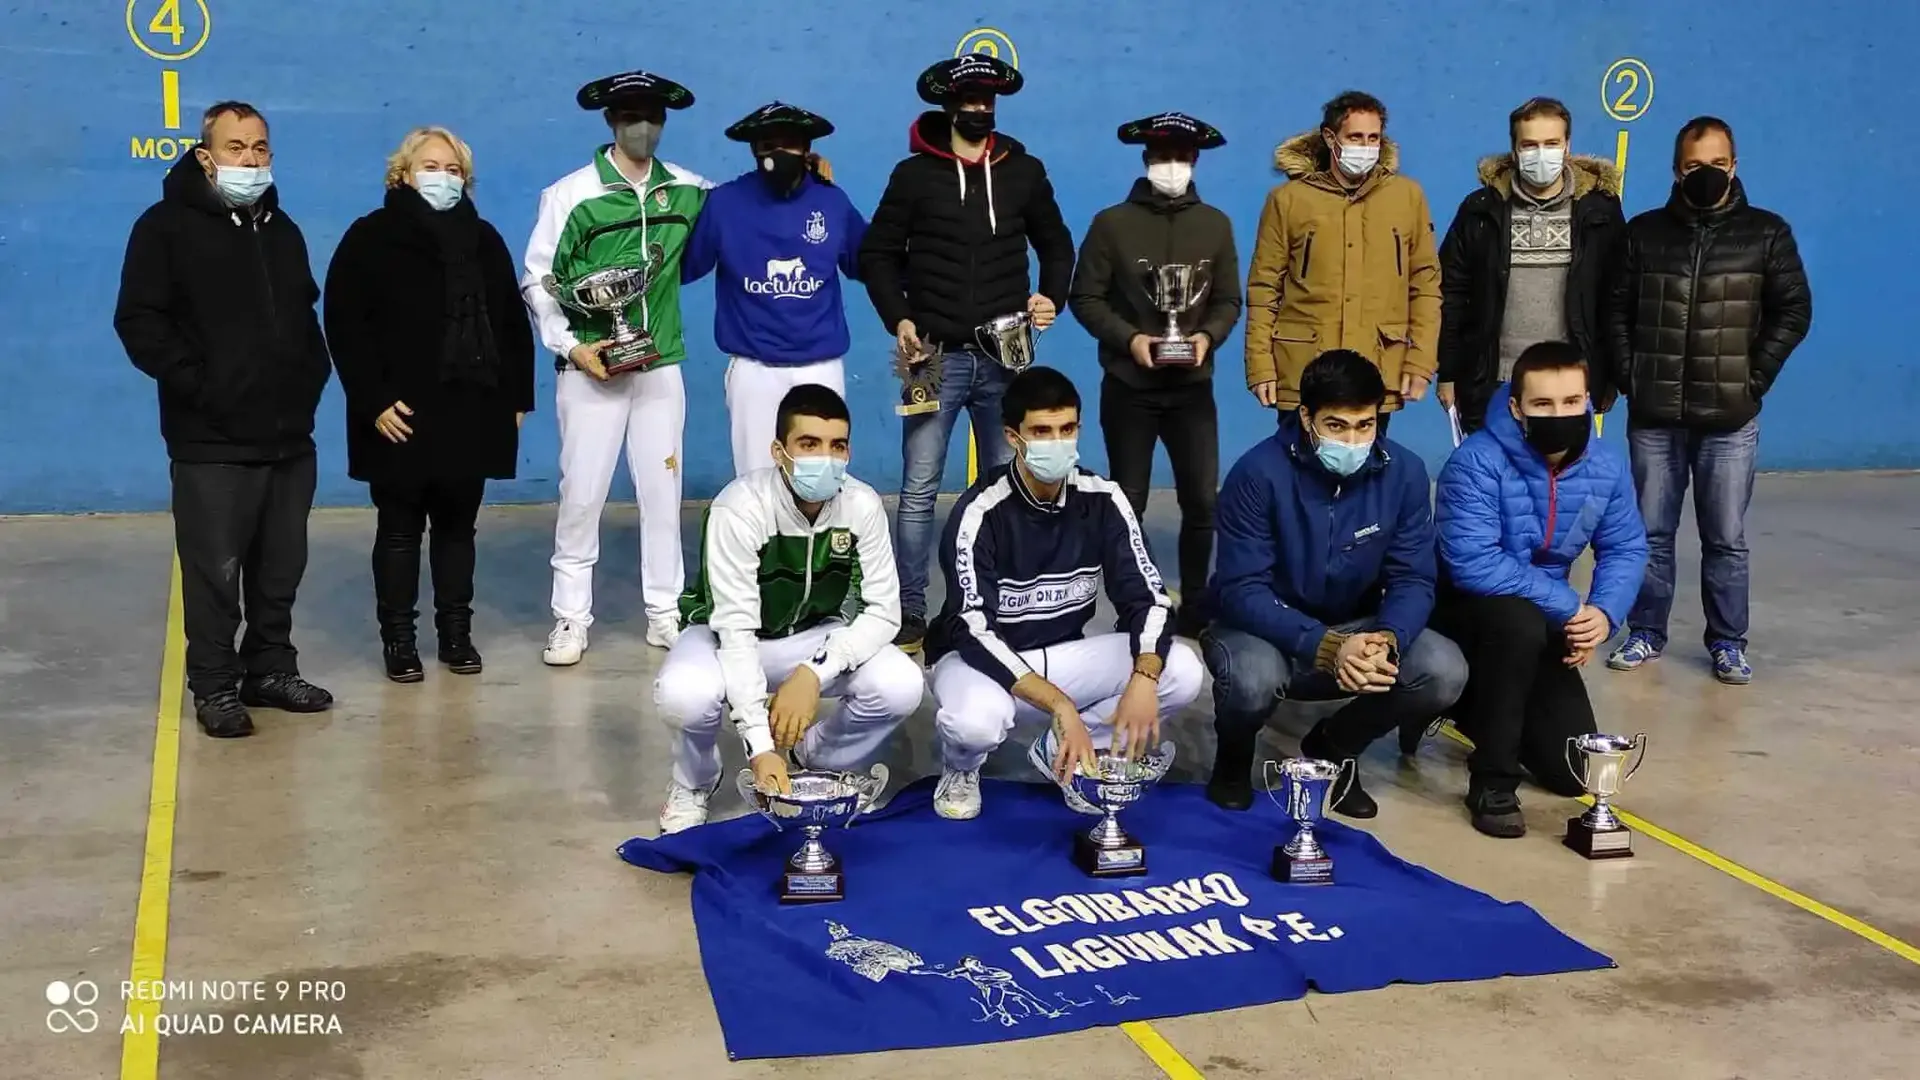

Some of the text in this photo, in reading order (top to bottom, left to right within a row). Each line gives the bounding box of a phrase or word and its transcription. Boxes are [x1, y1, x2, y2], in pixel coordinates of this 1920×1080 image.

[1614, 68, 1638, 111] 2
[131, 137, 202, 161] MOT
[1000, 593, 1031, 608] AGUN
[967, 872, 1250, 936] ELGOIBARKO
[1010, 918, 1254, 979] LAGUNAK
